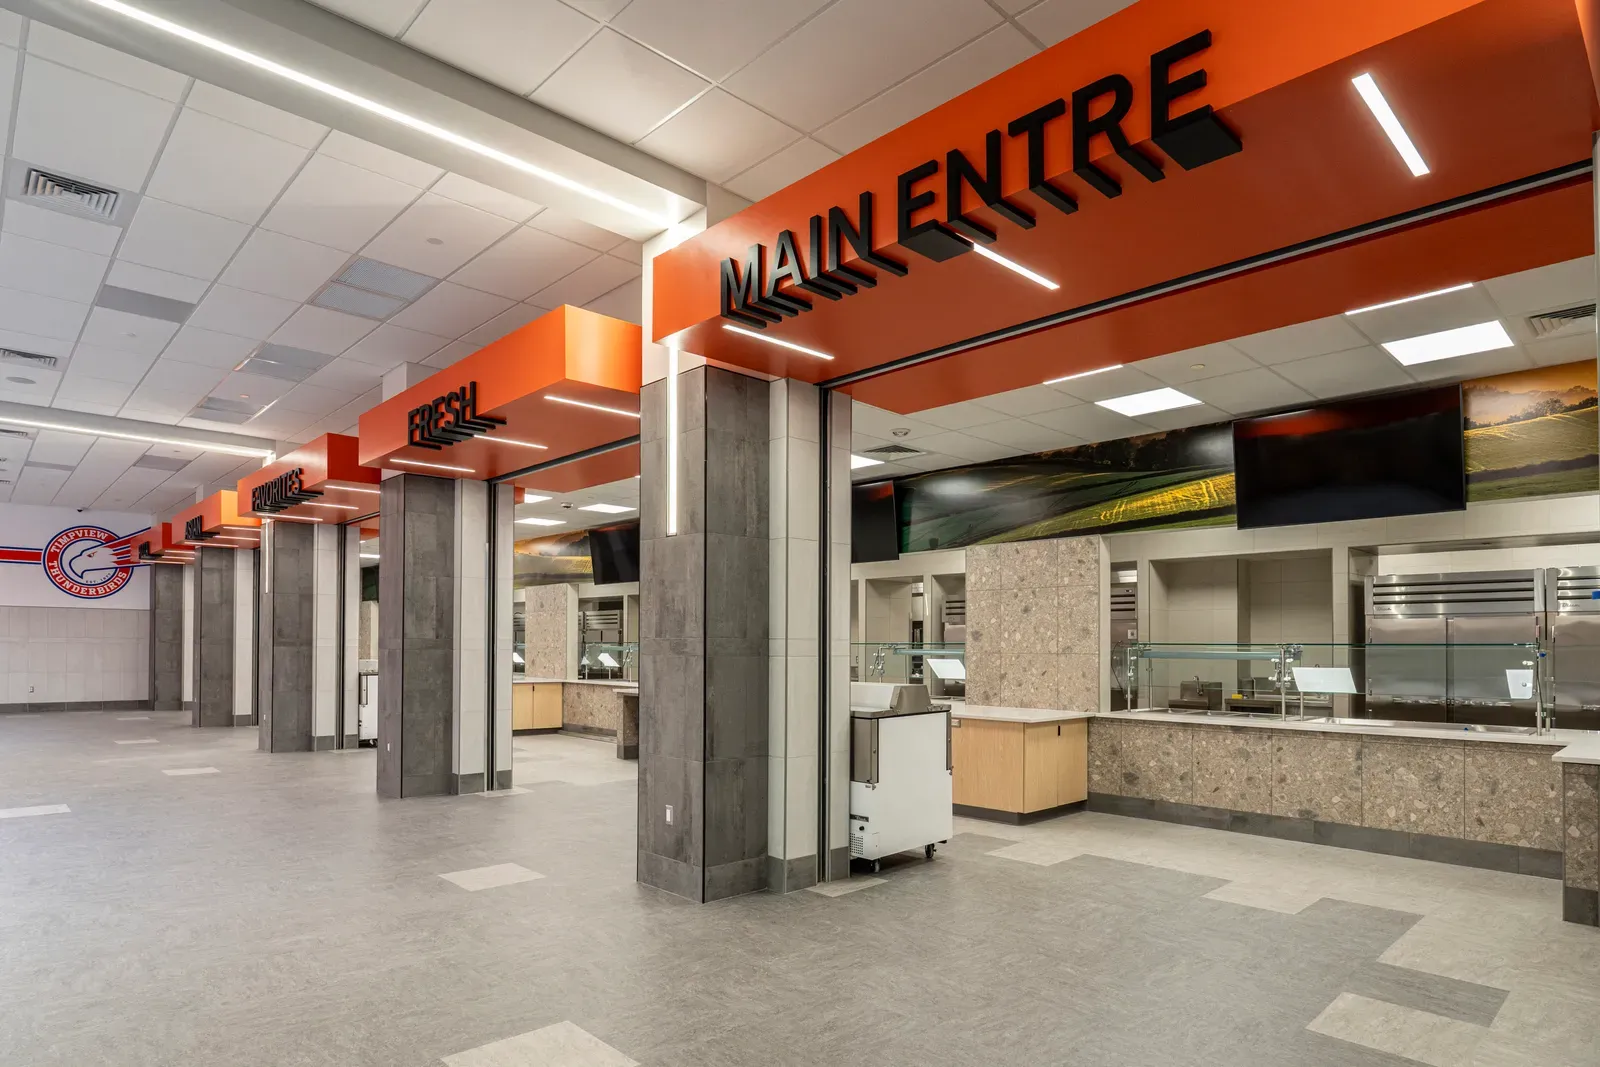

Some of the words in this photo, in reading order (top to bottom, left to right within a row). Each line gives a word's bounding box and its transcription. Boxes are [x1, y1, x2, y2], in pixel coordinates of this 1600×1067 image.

[720, 190, 876, 317] MAIN
[897, 28, 1213, 247] ENTRE
[408, 381, 478, 447] FRESH
[252, 467, 305, 512] FAVORITES
[51, 529, 108, 554] TIMPVIEW
[48, 560, 127, 596] THUNDERBIRDS
